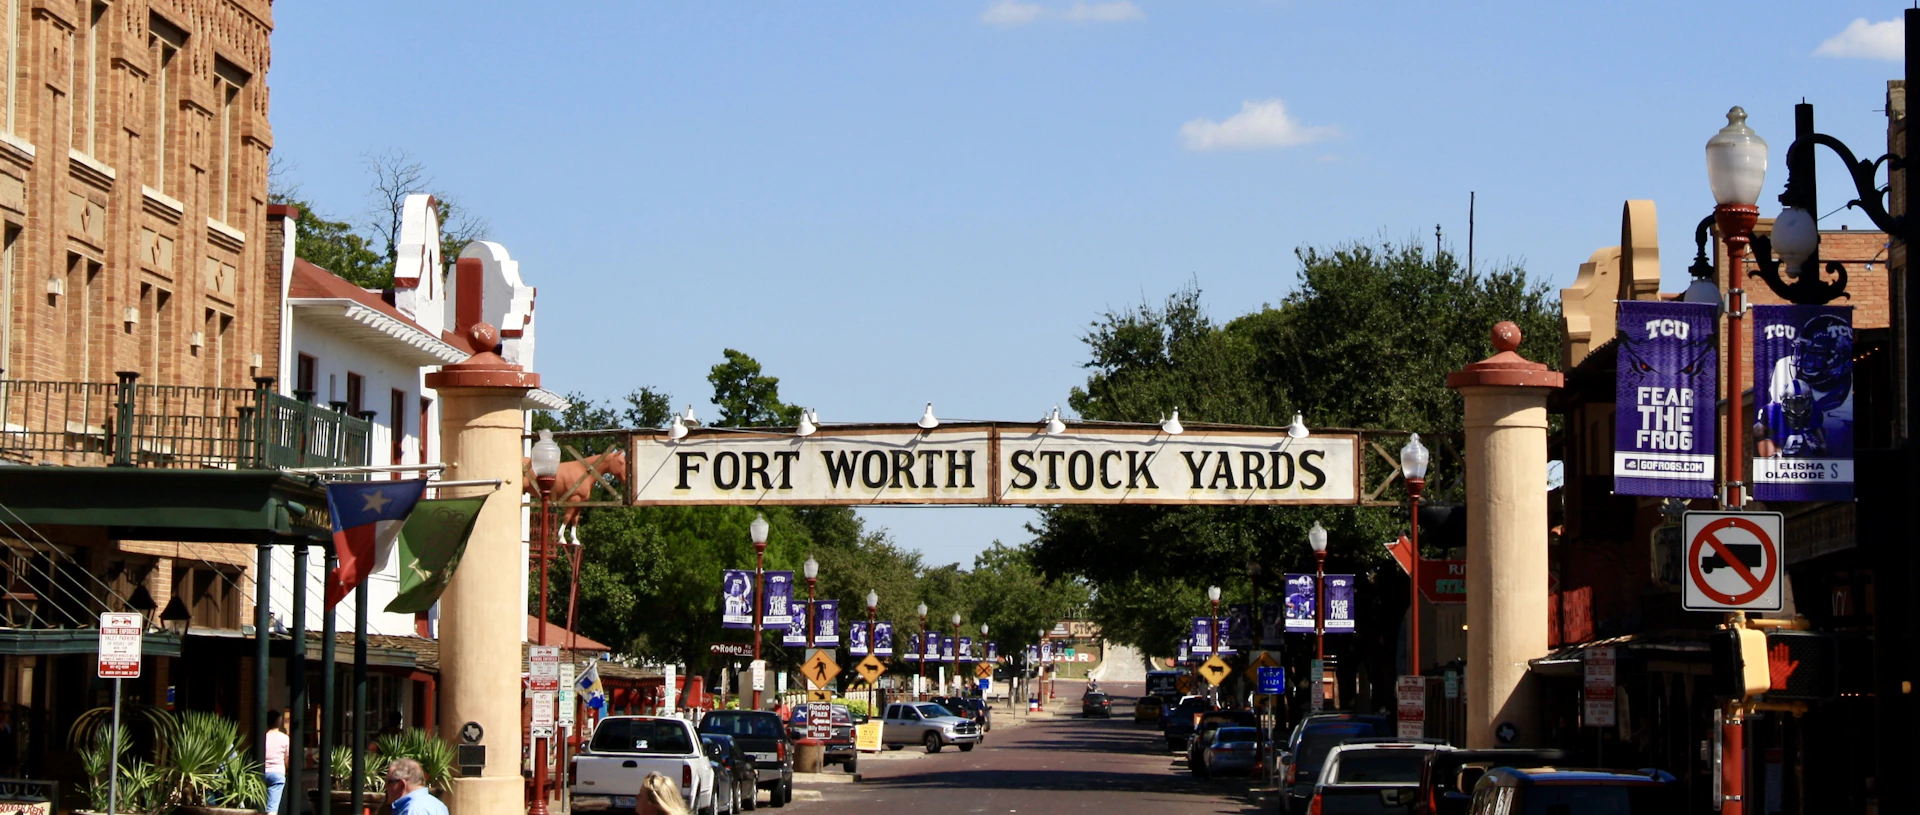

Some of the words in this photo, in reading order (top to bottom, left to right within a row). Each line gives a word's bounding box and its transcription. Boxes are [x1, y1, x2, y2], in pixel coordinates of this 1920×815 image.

[1646, 319, 1689, 340] TCU
[1764, 324, 1796, 340] TCU
[1637, 386, 1694, 407] FEAR
[1637, 405, 1694, 432] THE
[1636, 430, 1693, 451] FROG
[674, 450, 799, 490] FORT
[820, 449, 976, 489] WORTH
[1010, 450, 1159, 490] STOCK
[1180, 450, 1326, 490] YARDS
[1640, 460, 1703, 472] GOFROGS.COM
[1780, 462, 1824, 470] ELISHA
[1765, 471, 1824, 479] OLABODE
[1332, 579, 1346, 587] TCU
[720, 644, 742, 654] Rodeo
